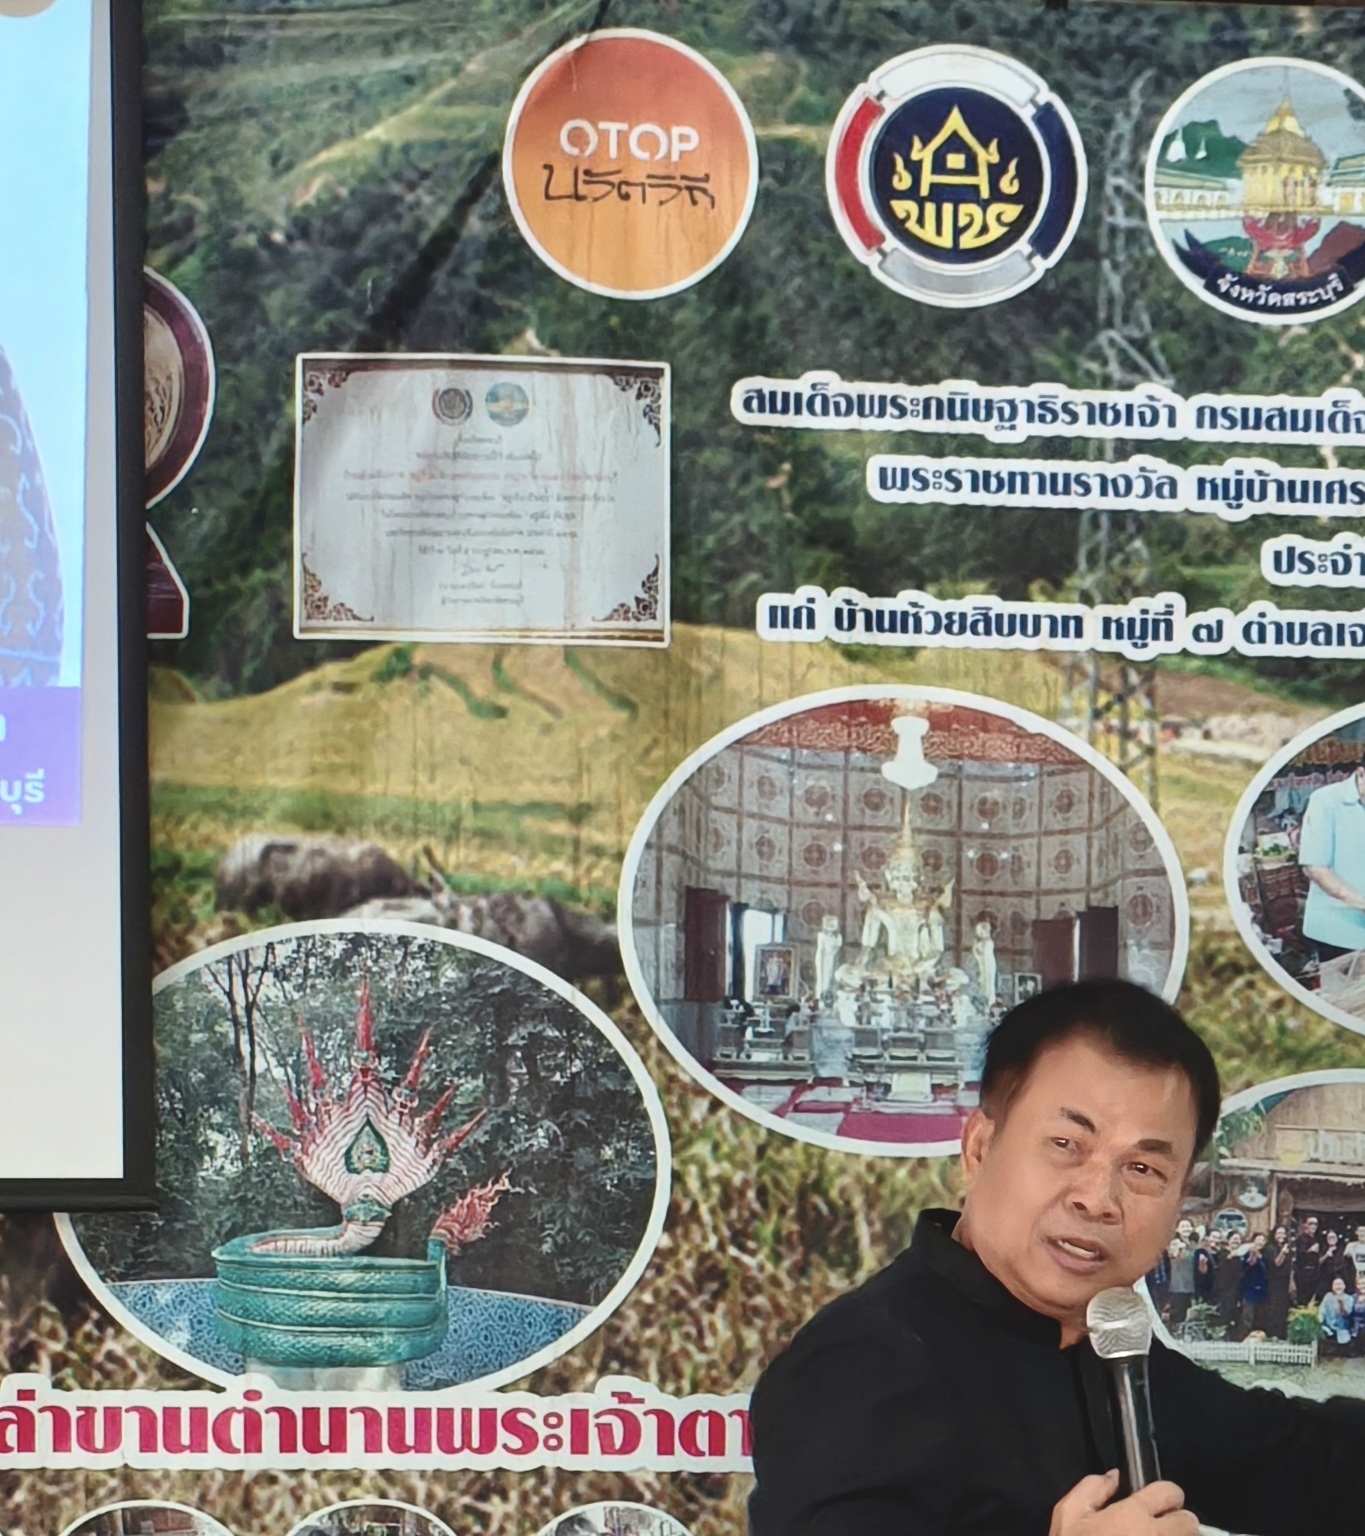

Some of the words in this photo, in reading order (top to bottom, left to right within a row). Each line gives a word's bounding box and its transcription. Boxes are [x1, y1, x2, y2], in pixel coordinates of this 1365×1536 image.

[560, 118, 699, 162] OTOP
[742, 382, 1178, 433] สมเด็จพระกนิษฐาธิราชเจ้า
[878, 460, 1178, 495] พระราชทานรางวัล
[768, 597, 816, 632] แก่
[834, 595, 1084, 642] บ้านห้วยสิบบาท
[1102, 604, 1174, 649] หมู่ที่
[1192, 620, 1224, 645] ๗
